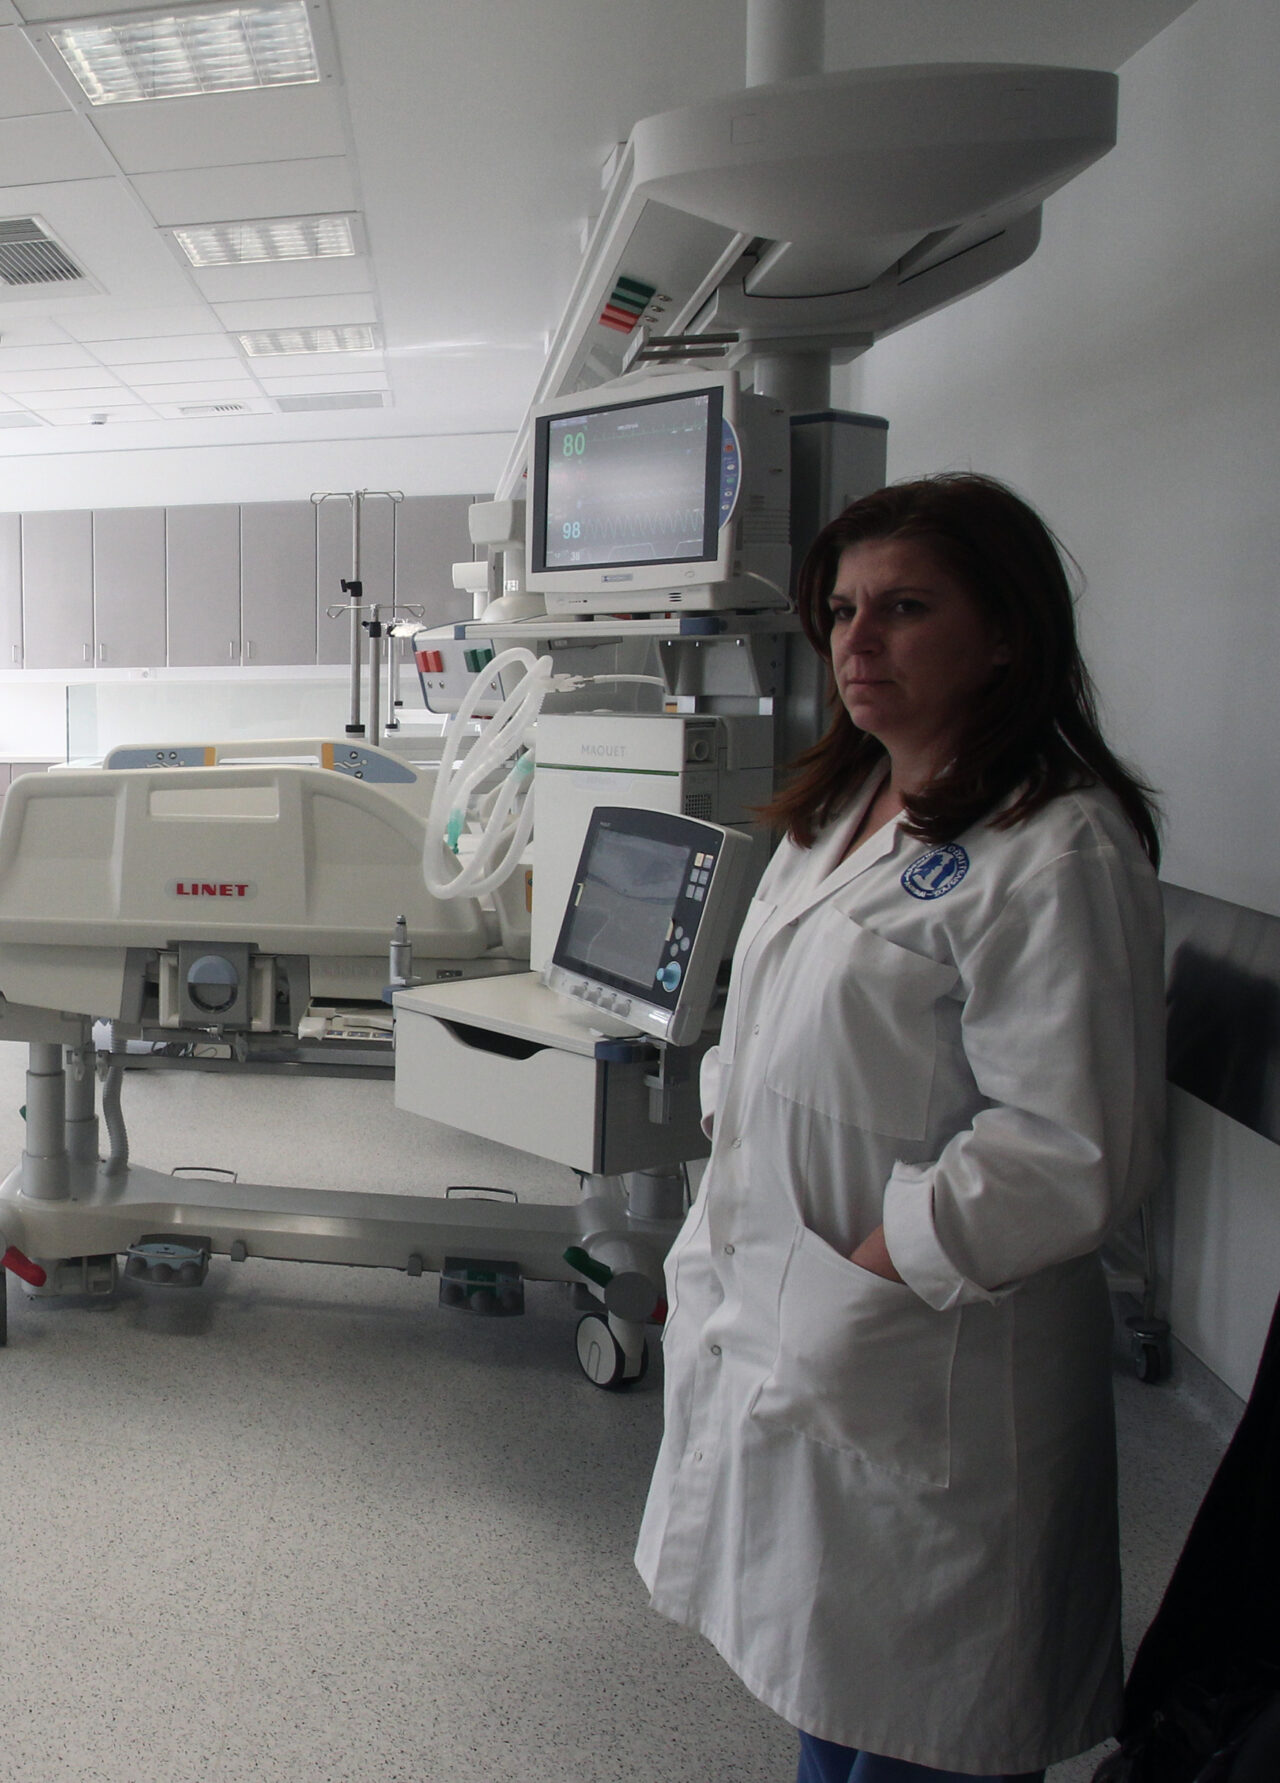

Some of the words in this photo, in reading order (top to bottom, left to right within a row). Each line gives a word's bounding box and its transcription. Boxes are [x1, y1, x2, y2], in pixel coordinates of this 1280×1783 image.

[563, 432, 585, 457] 80
[563, 521, 580, 539] 98
[176, 883, 249, 897] LINET
